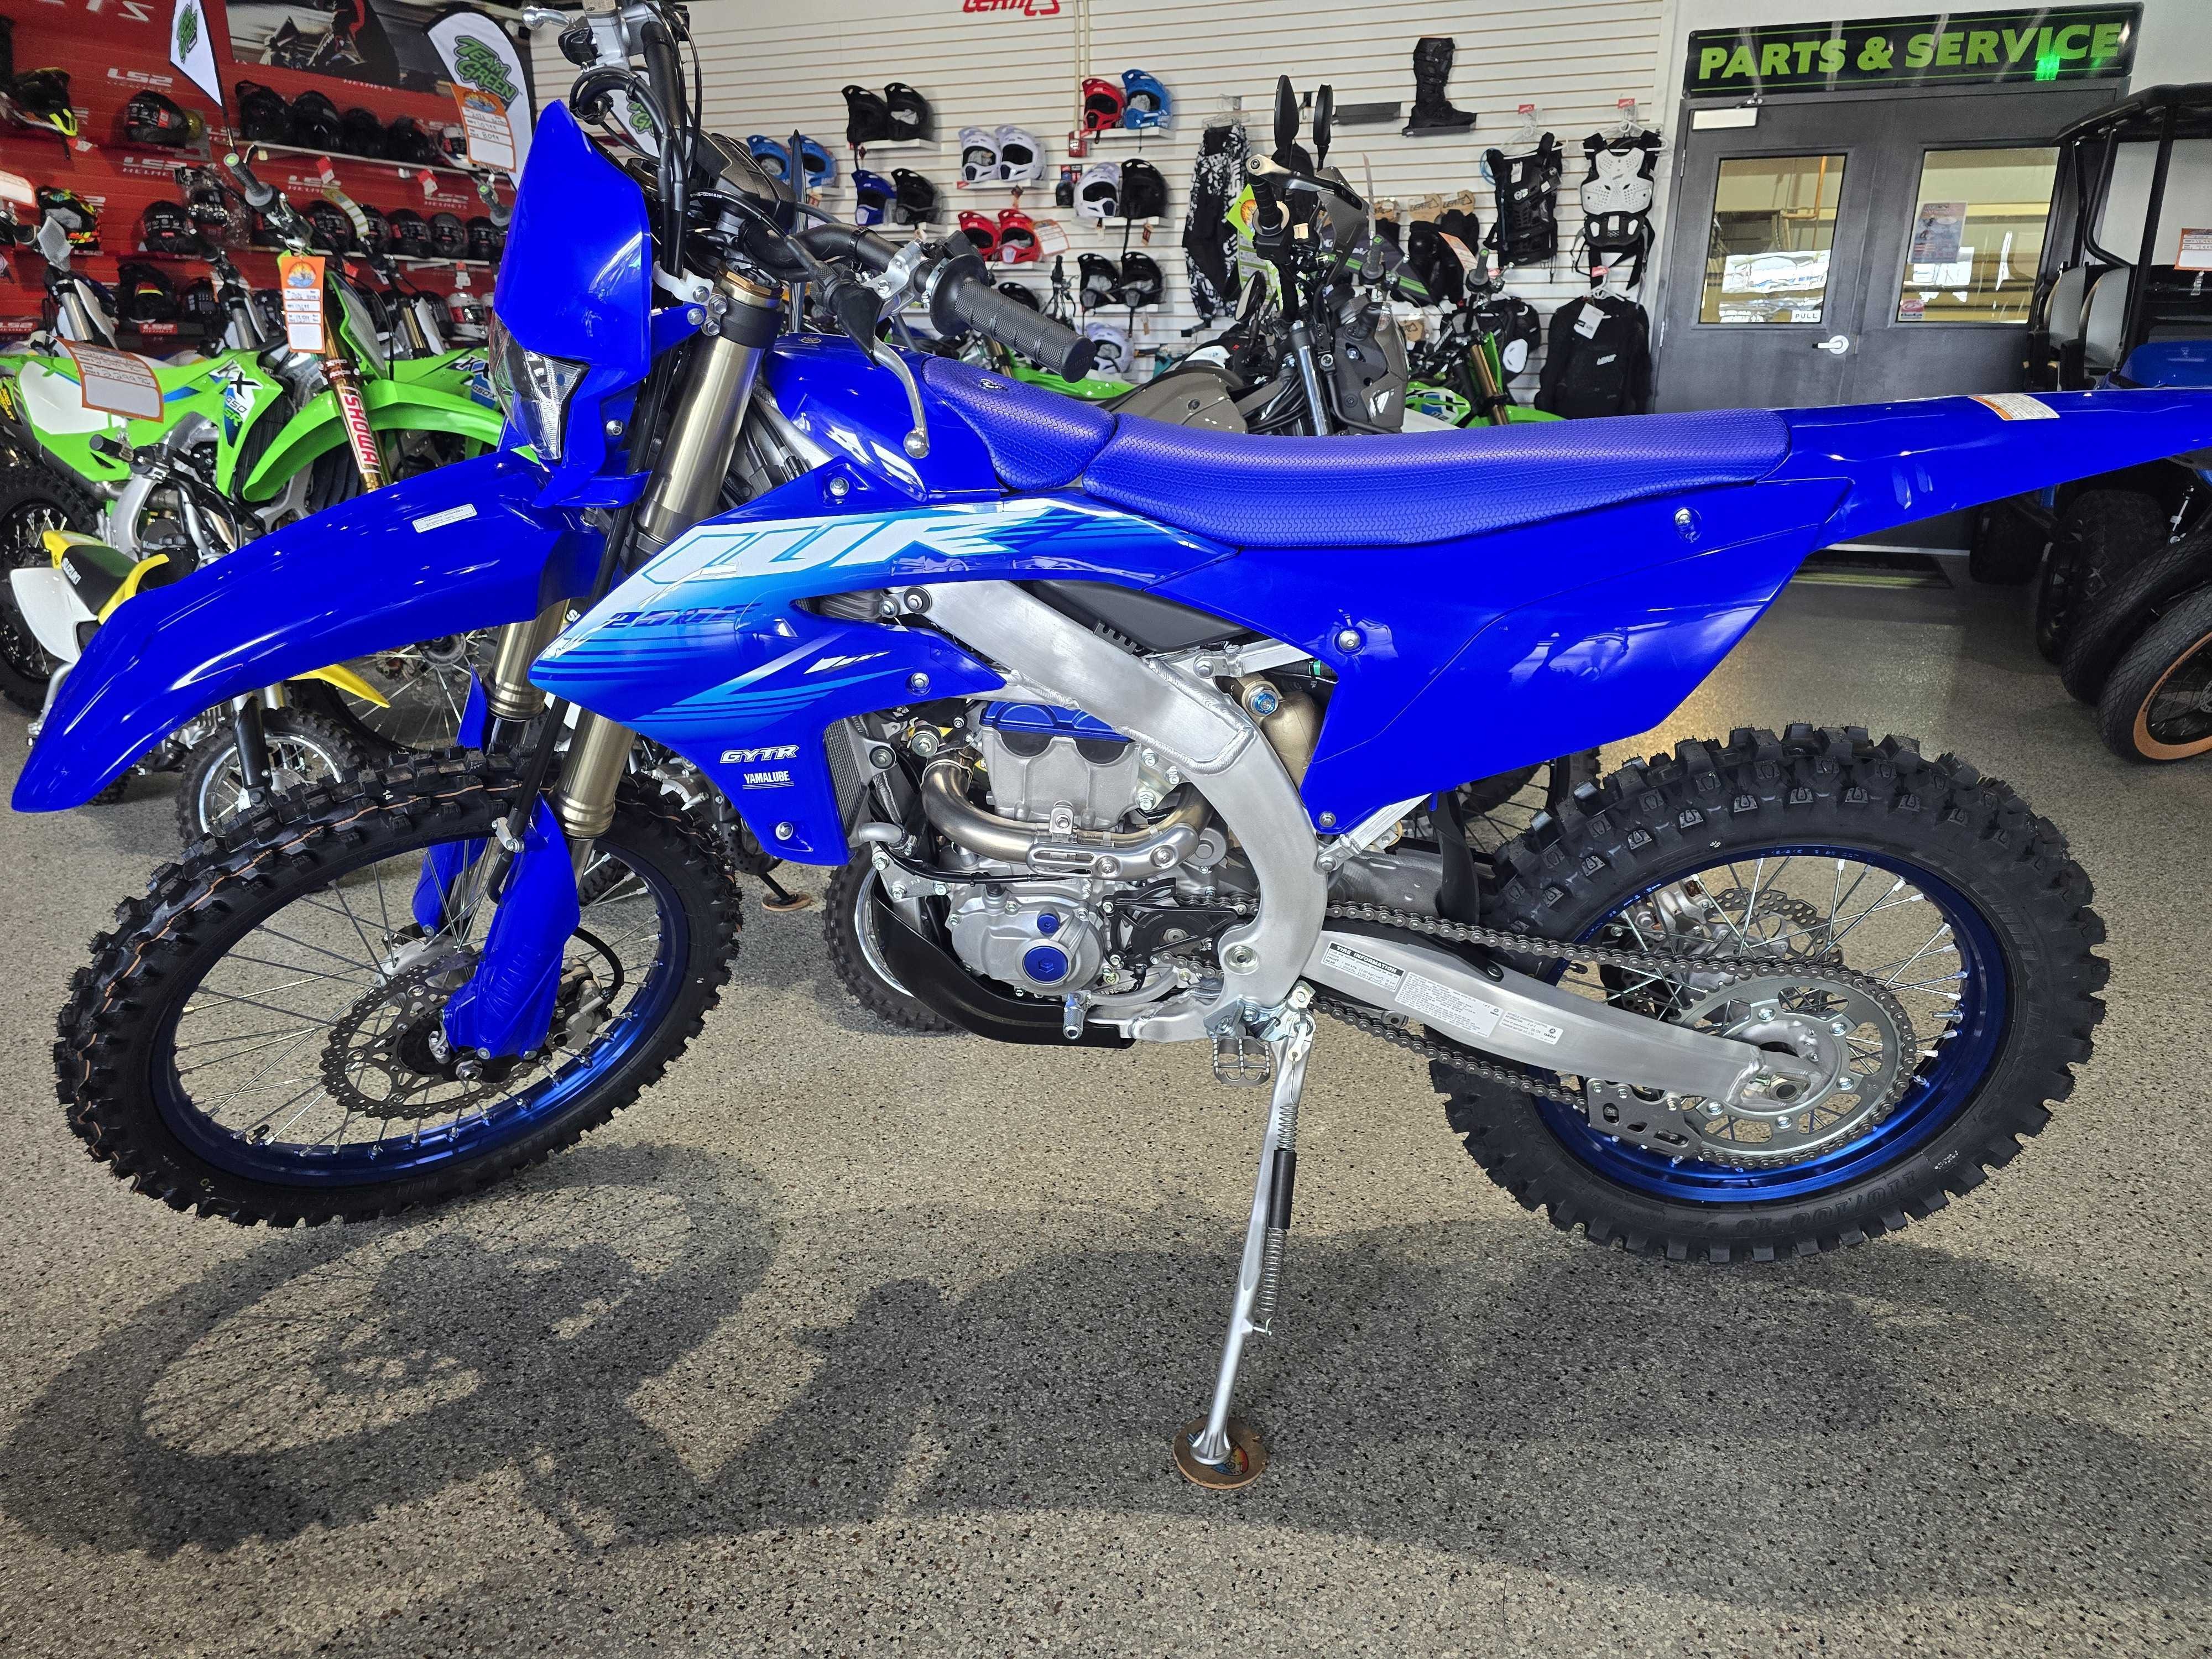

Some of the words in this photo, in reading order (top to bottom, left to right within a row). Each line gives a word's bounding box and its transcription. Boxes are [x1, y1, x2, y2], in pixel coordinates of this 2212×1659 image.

[454, 35, 509, 79] TEAM
[1698, 38, 1846, 80] PARTS
[1858, 36, 1893, 71] &
[1905, 23, 2124, 70] SERVICE
[107, 67, 173, 87] LS2
[455, 59, 519, 102] GREEN
[216, 359, 263, 400] KX
[344, 394, 379, 465] SHOWA
[61, 557, 81, 586] SUZUKI
[720, 745, 800, 764] GYTR
[744, 770, 790, 784] YAMALUBE
[1336, 946, 1352, 955] TIRE
[1353, 952, 1397, 974] INFORMATION
